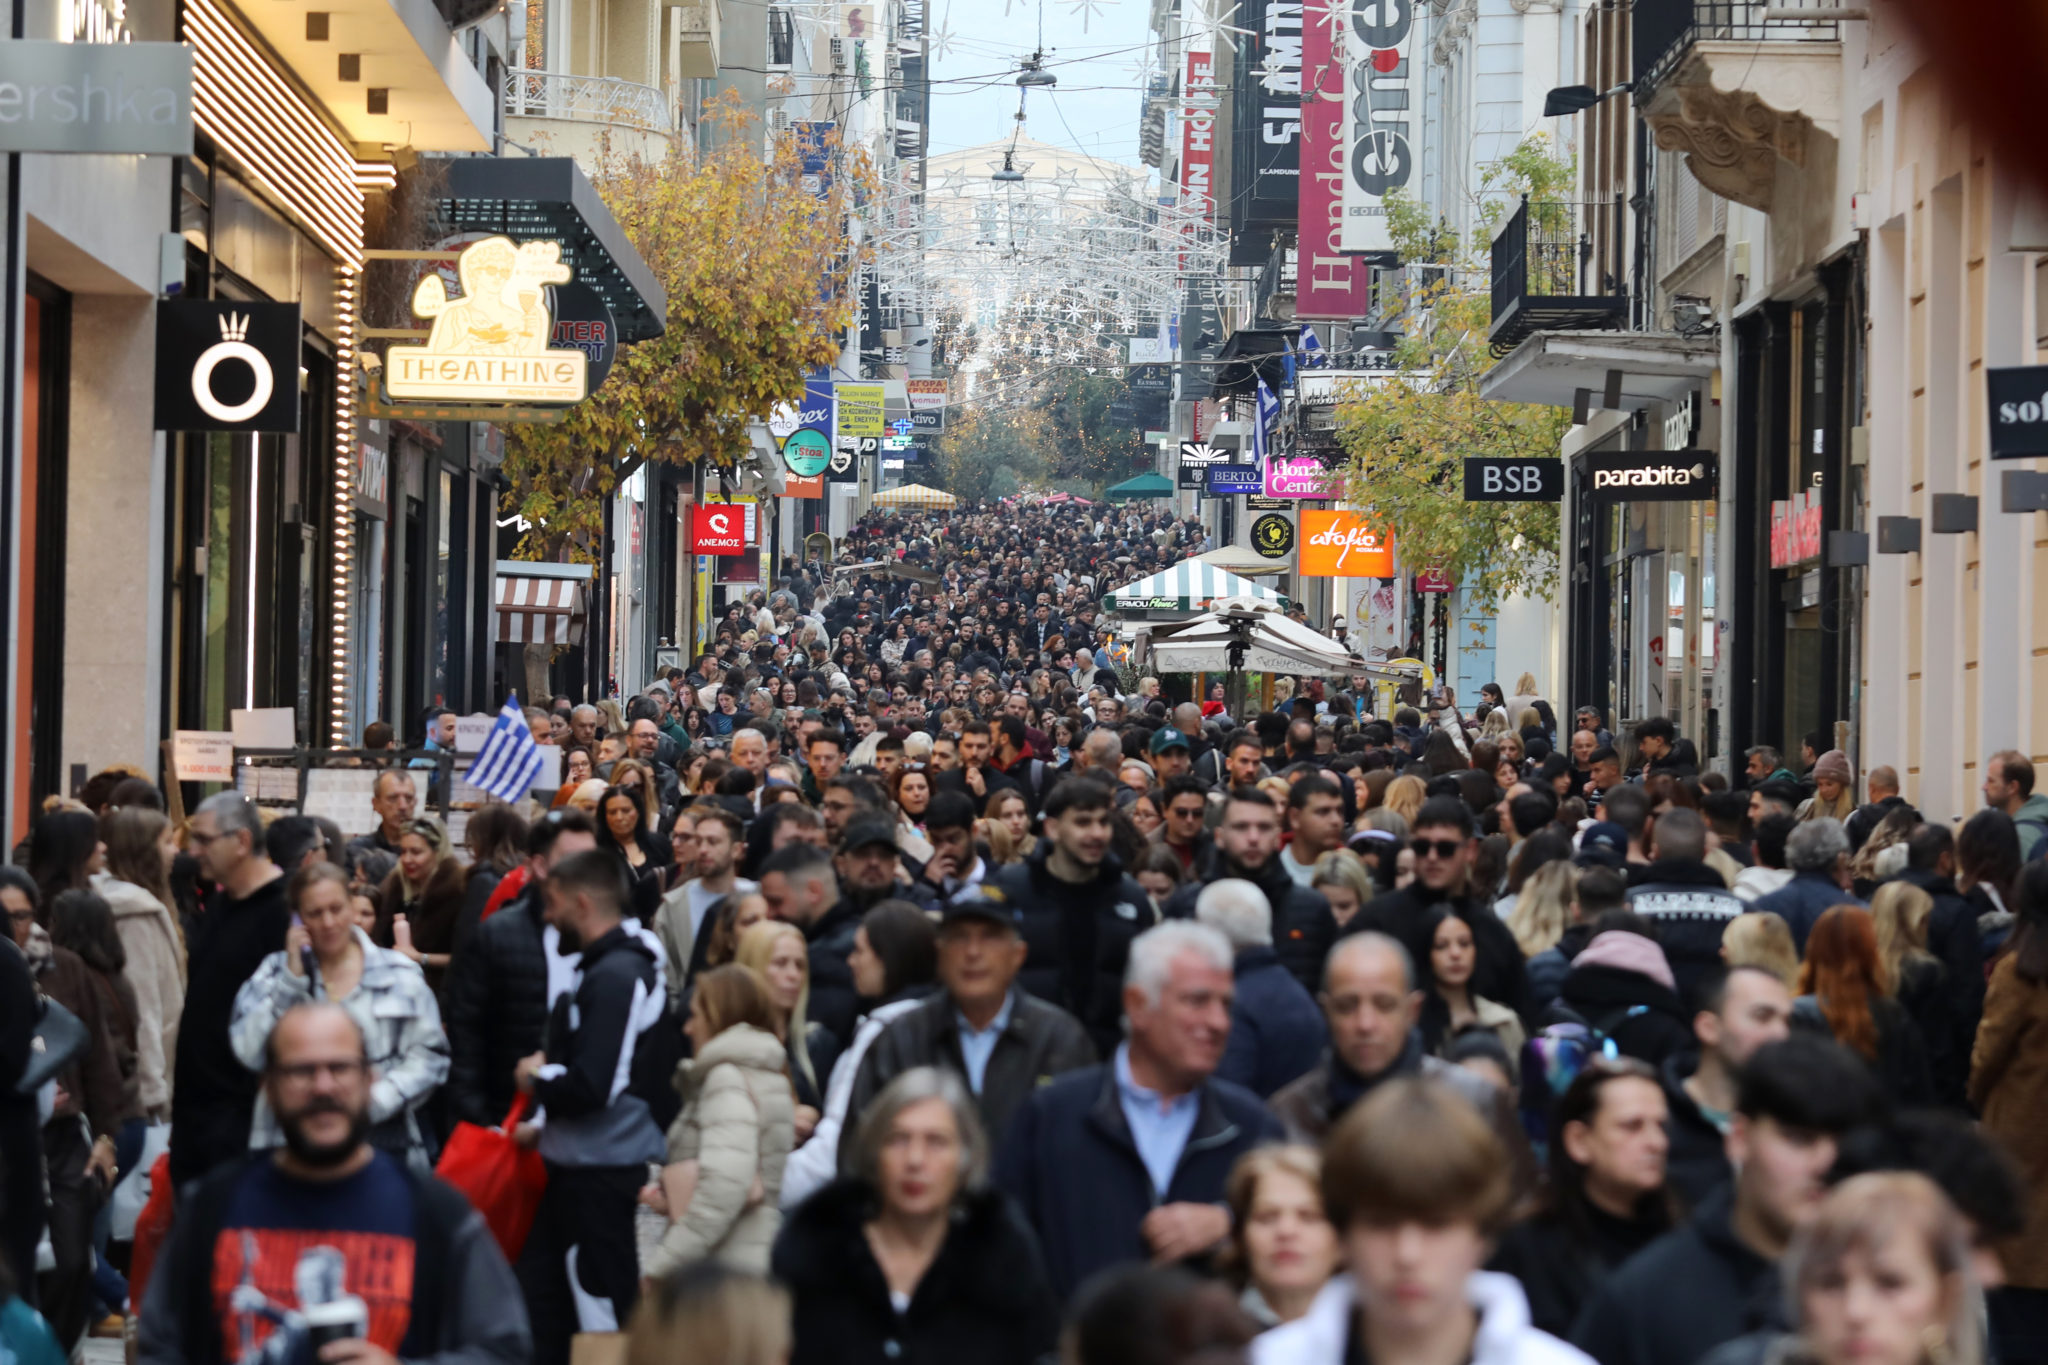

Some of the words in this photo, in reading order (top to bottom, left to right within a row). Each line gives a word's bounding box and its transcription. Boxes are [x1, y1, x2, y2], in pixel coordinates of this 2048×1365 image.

[1214, 471, 1257, 482] BERTO
[1483, 466, 1542, 493] BSB
[1595, 465, 1690, 490] parabita
[697, 539, 740, 547] ΑΝΕΜΟΣ
[1116, 600, 1149, 608] ERMOU
